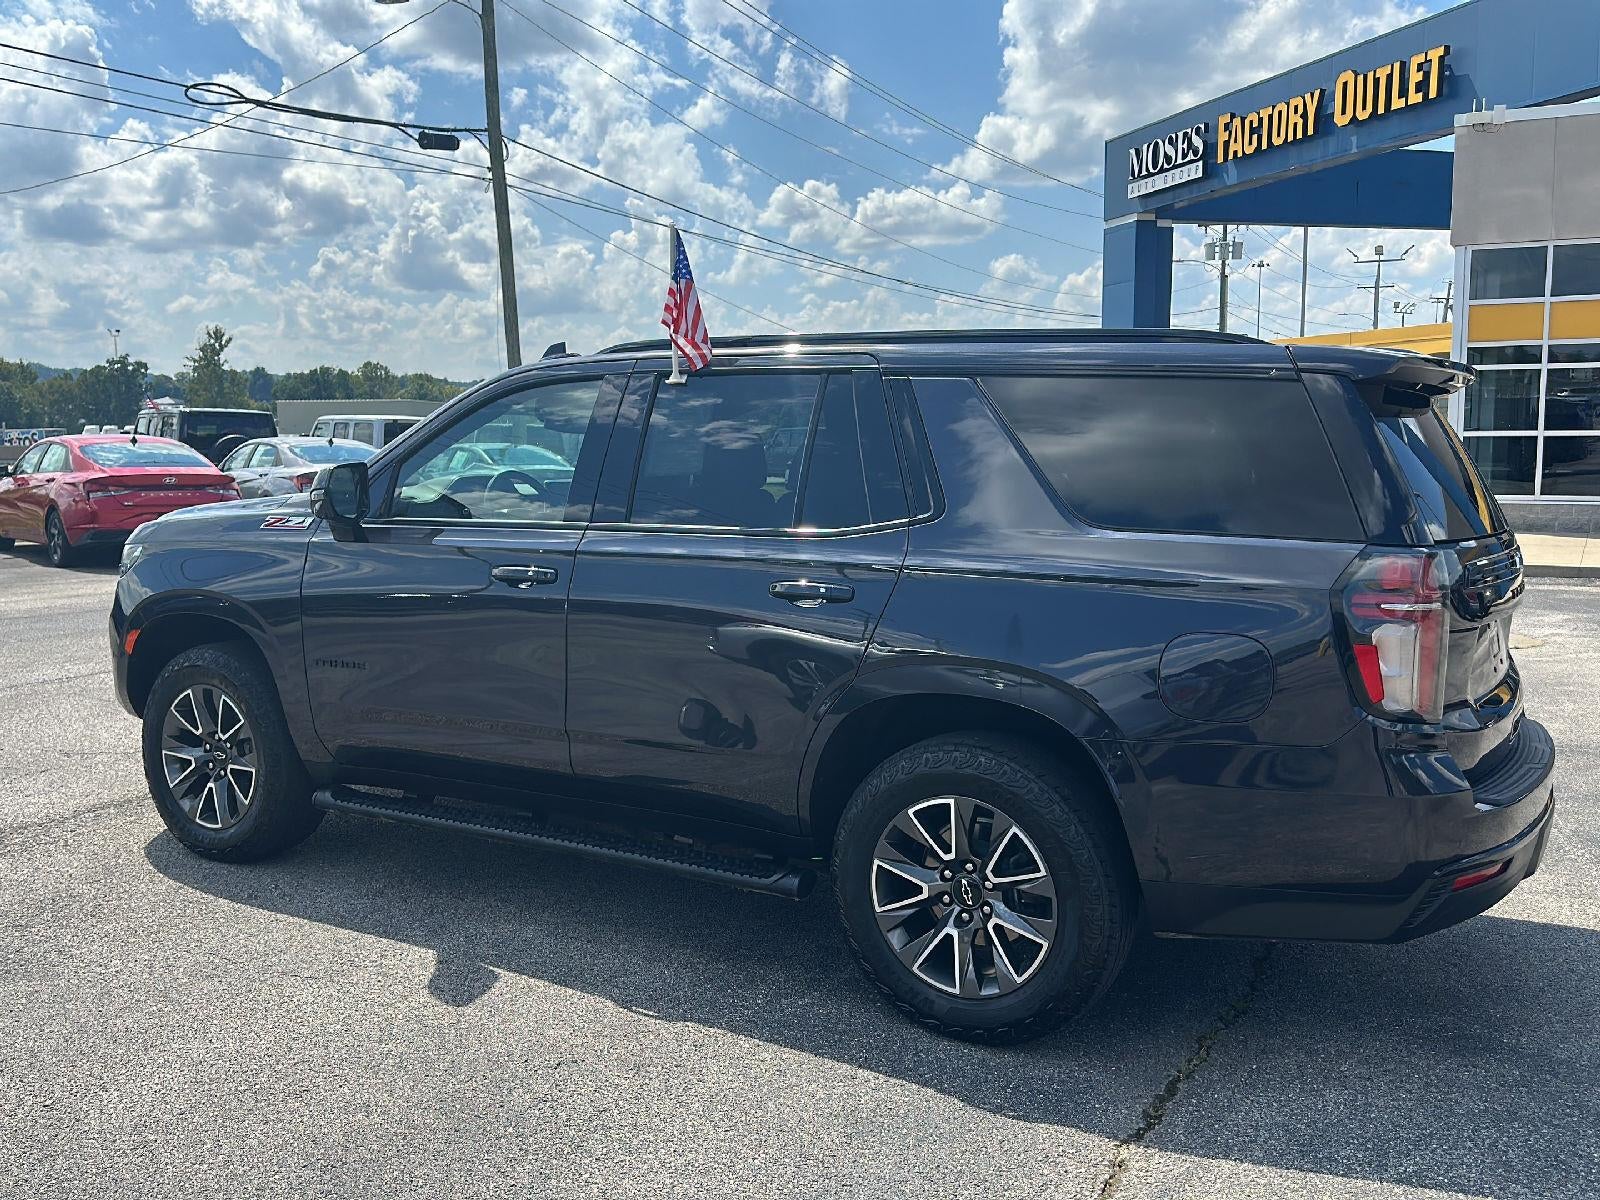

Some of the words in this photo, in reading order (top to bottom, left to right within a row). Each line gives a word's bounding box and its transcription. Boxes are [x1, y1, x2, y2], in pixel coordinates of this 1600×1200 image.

[1217, 88, 1323, 164] FACTORY
[1333, 45, 1447, 127] OUTLET
[1128, 123, 1205, 181] MOSES
[1129, 178, 1156, 196] AUTO
[1163, 164, 1200, 185] GROUP
